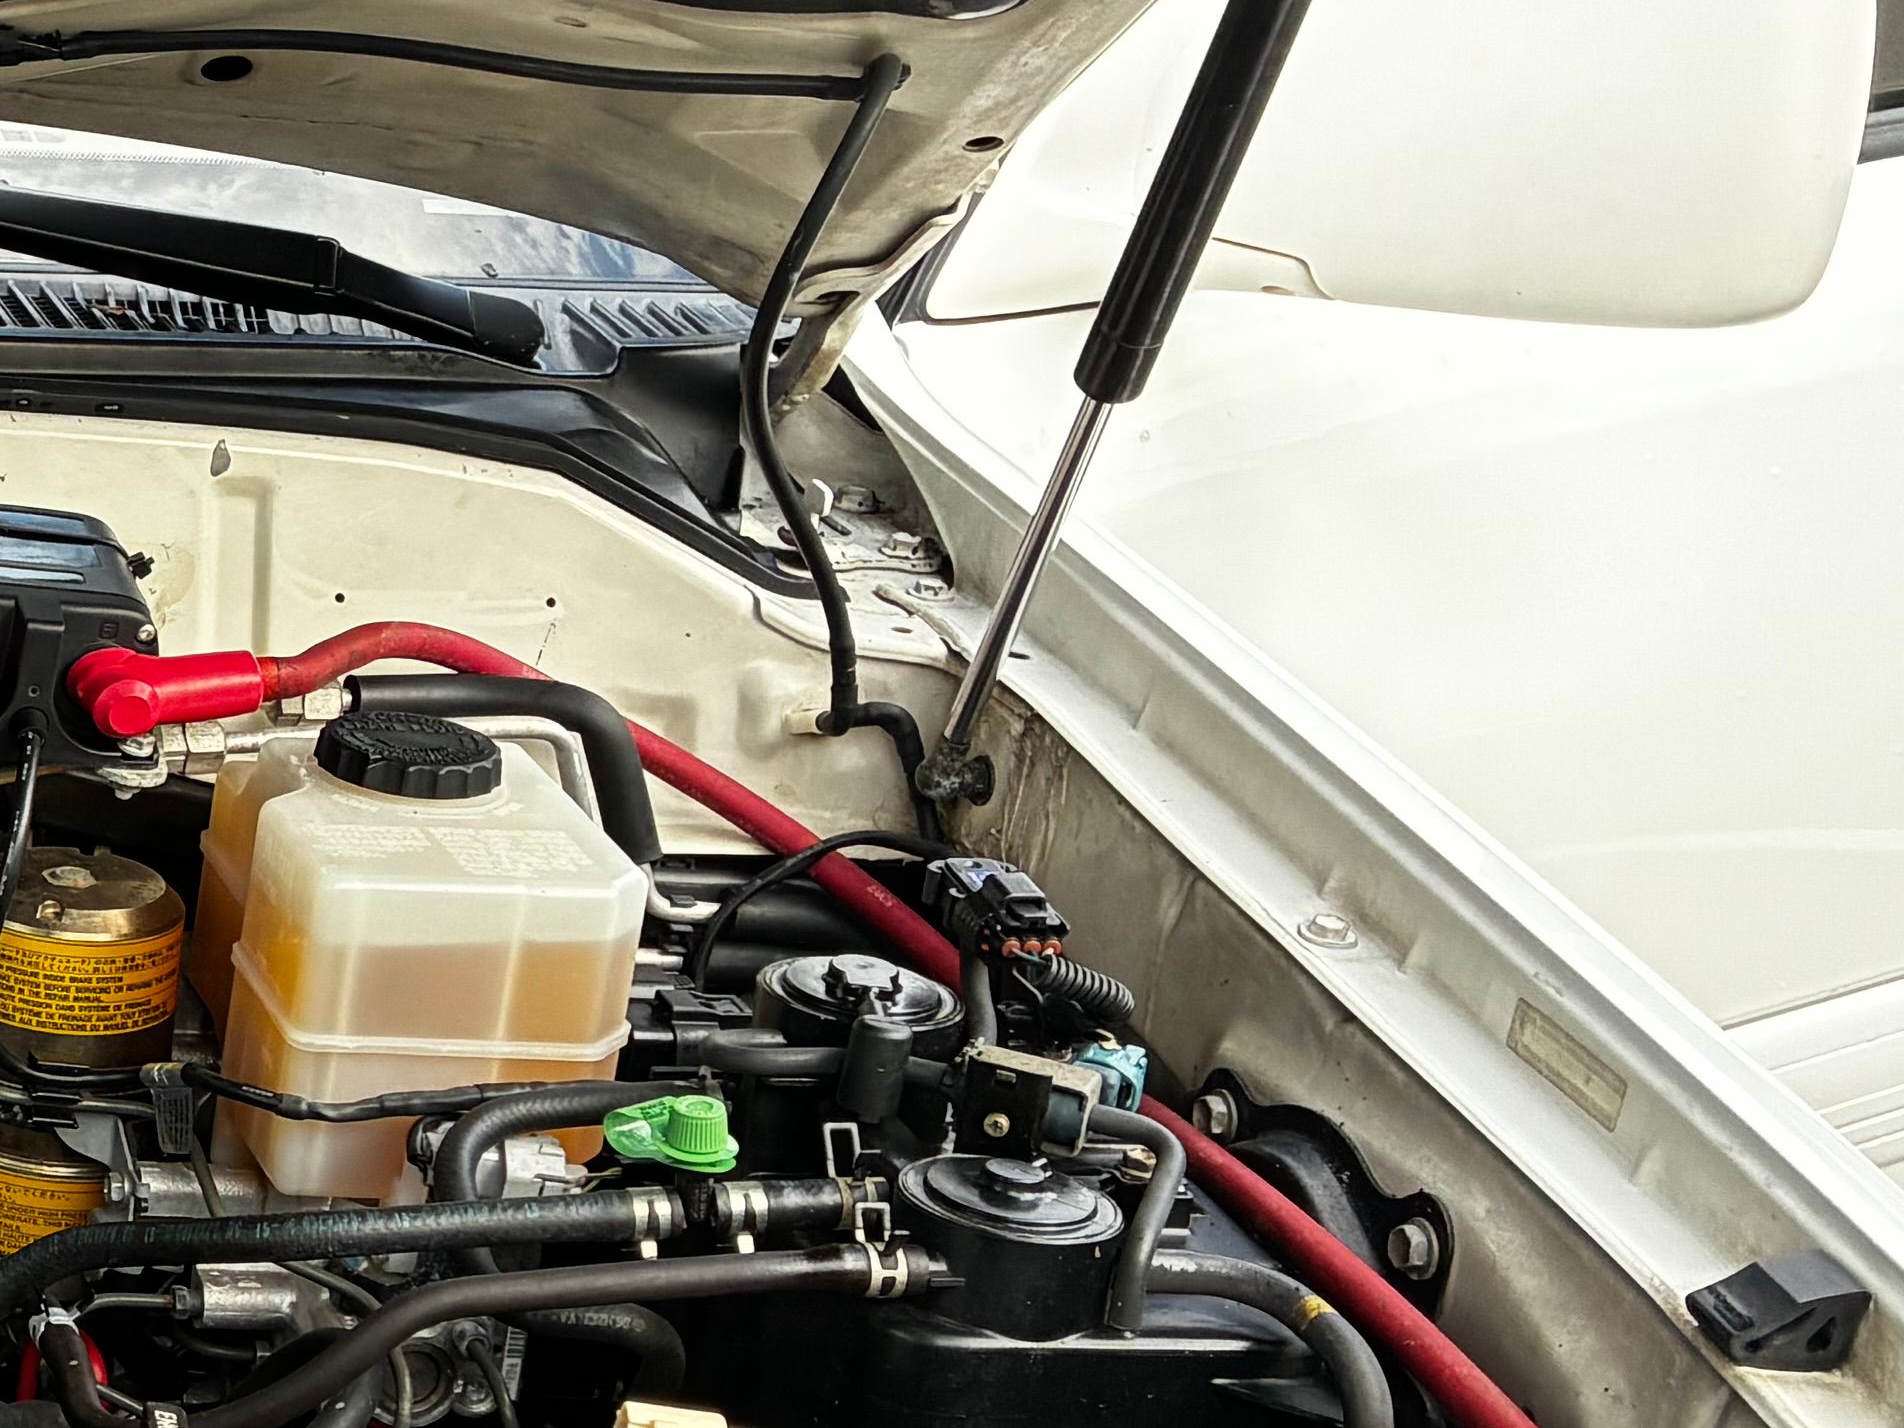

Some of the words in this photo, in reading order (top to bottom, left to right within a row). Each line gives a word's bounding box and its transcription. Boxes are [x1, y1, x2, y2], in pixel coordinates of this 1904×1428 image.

[69, 975, 94, 984] BRAKE
[96, 975, 124, 984] SYSTEM
[6, 1204, 35, 1216] UNDER
